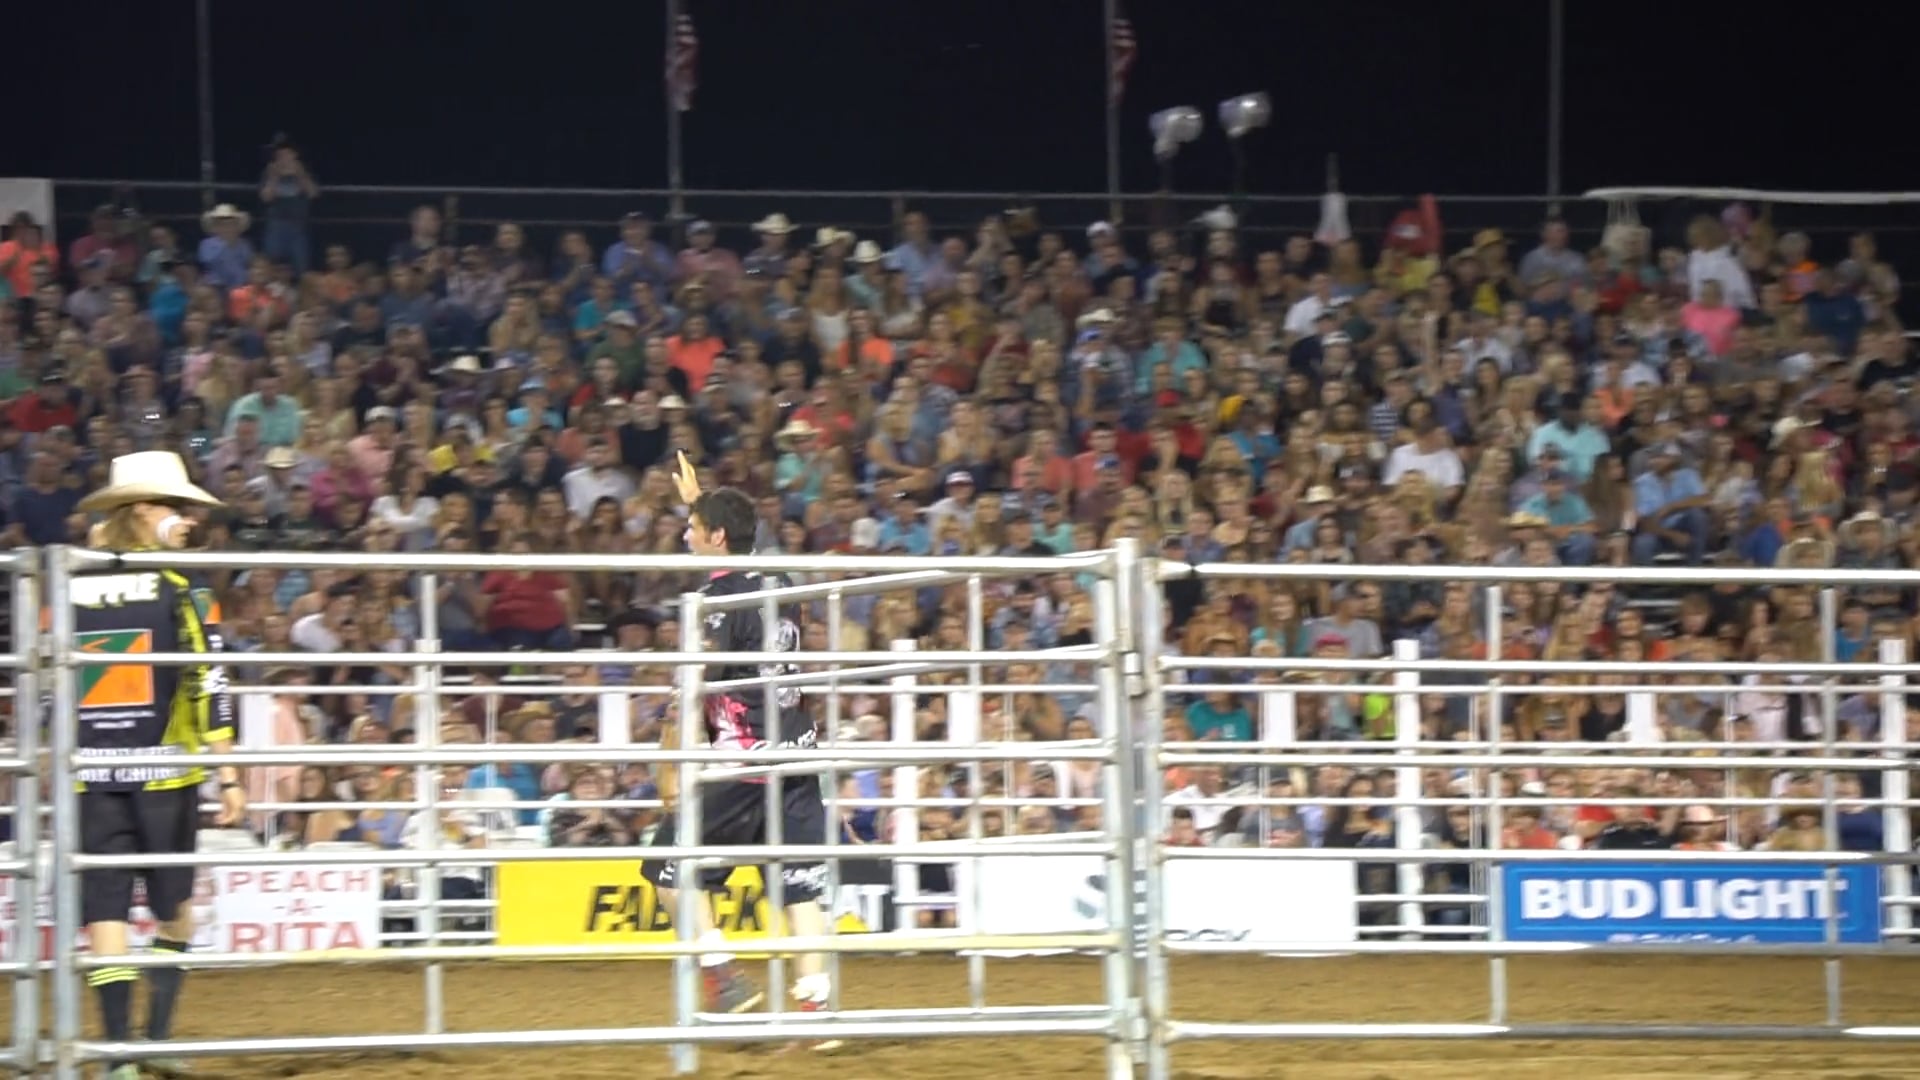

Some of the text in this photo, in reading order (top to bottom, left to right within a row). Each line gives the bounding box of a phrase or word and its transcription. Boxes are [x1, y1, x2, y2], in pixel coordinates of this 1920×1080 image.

[227, 869, 370, 893] PEACH
[1520, 878, 1848, 920] BUD LIGHT
[229, 921, 365, 952] RITA
